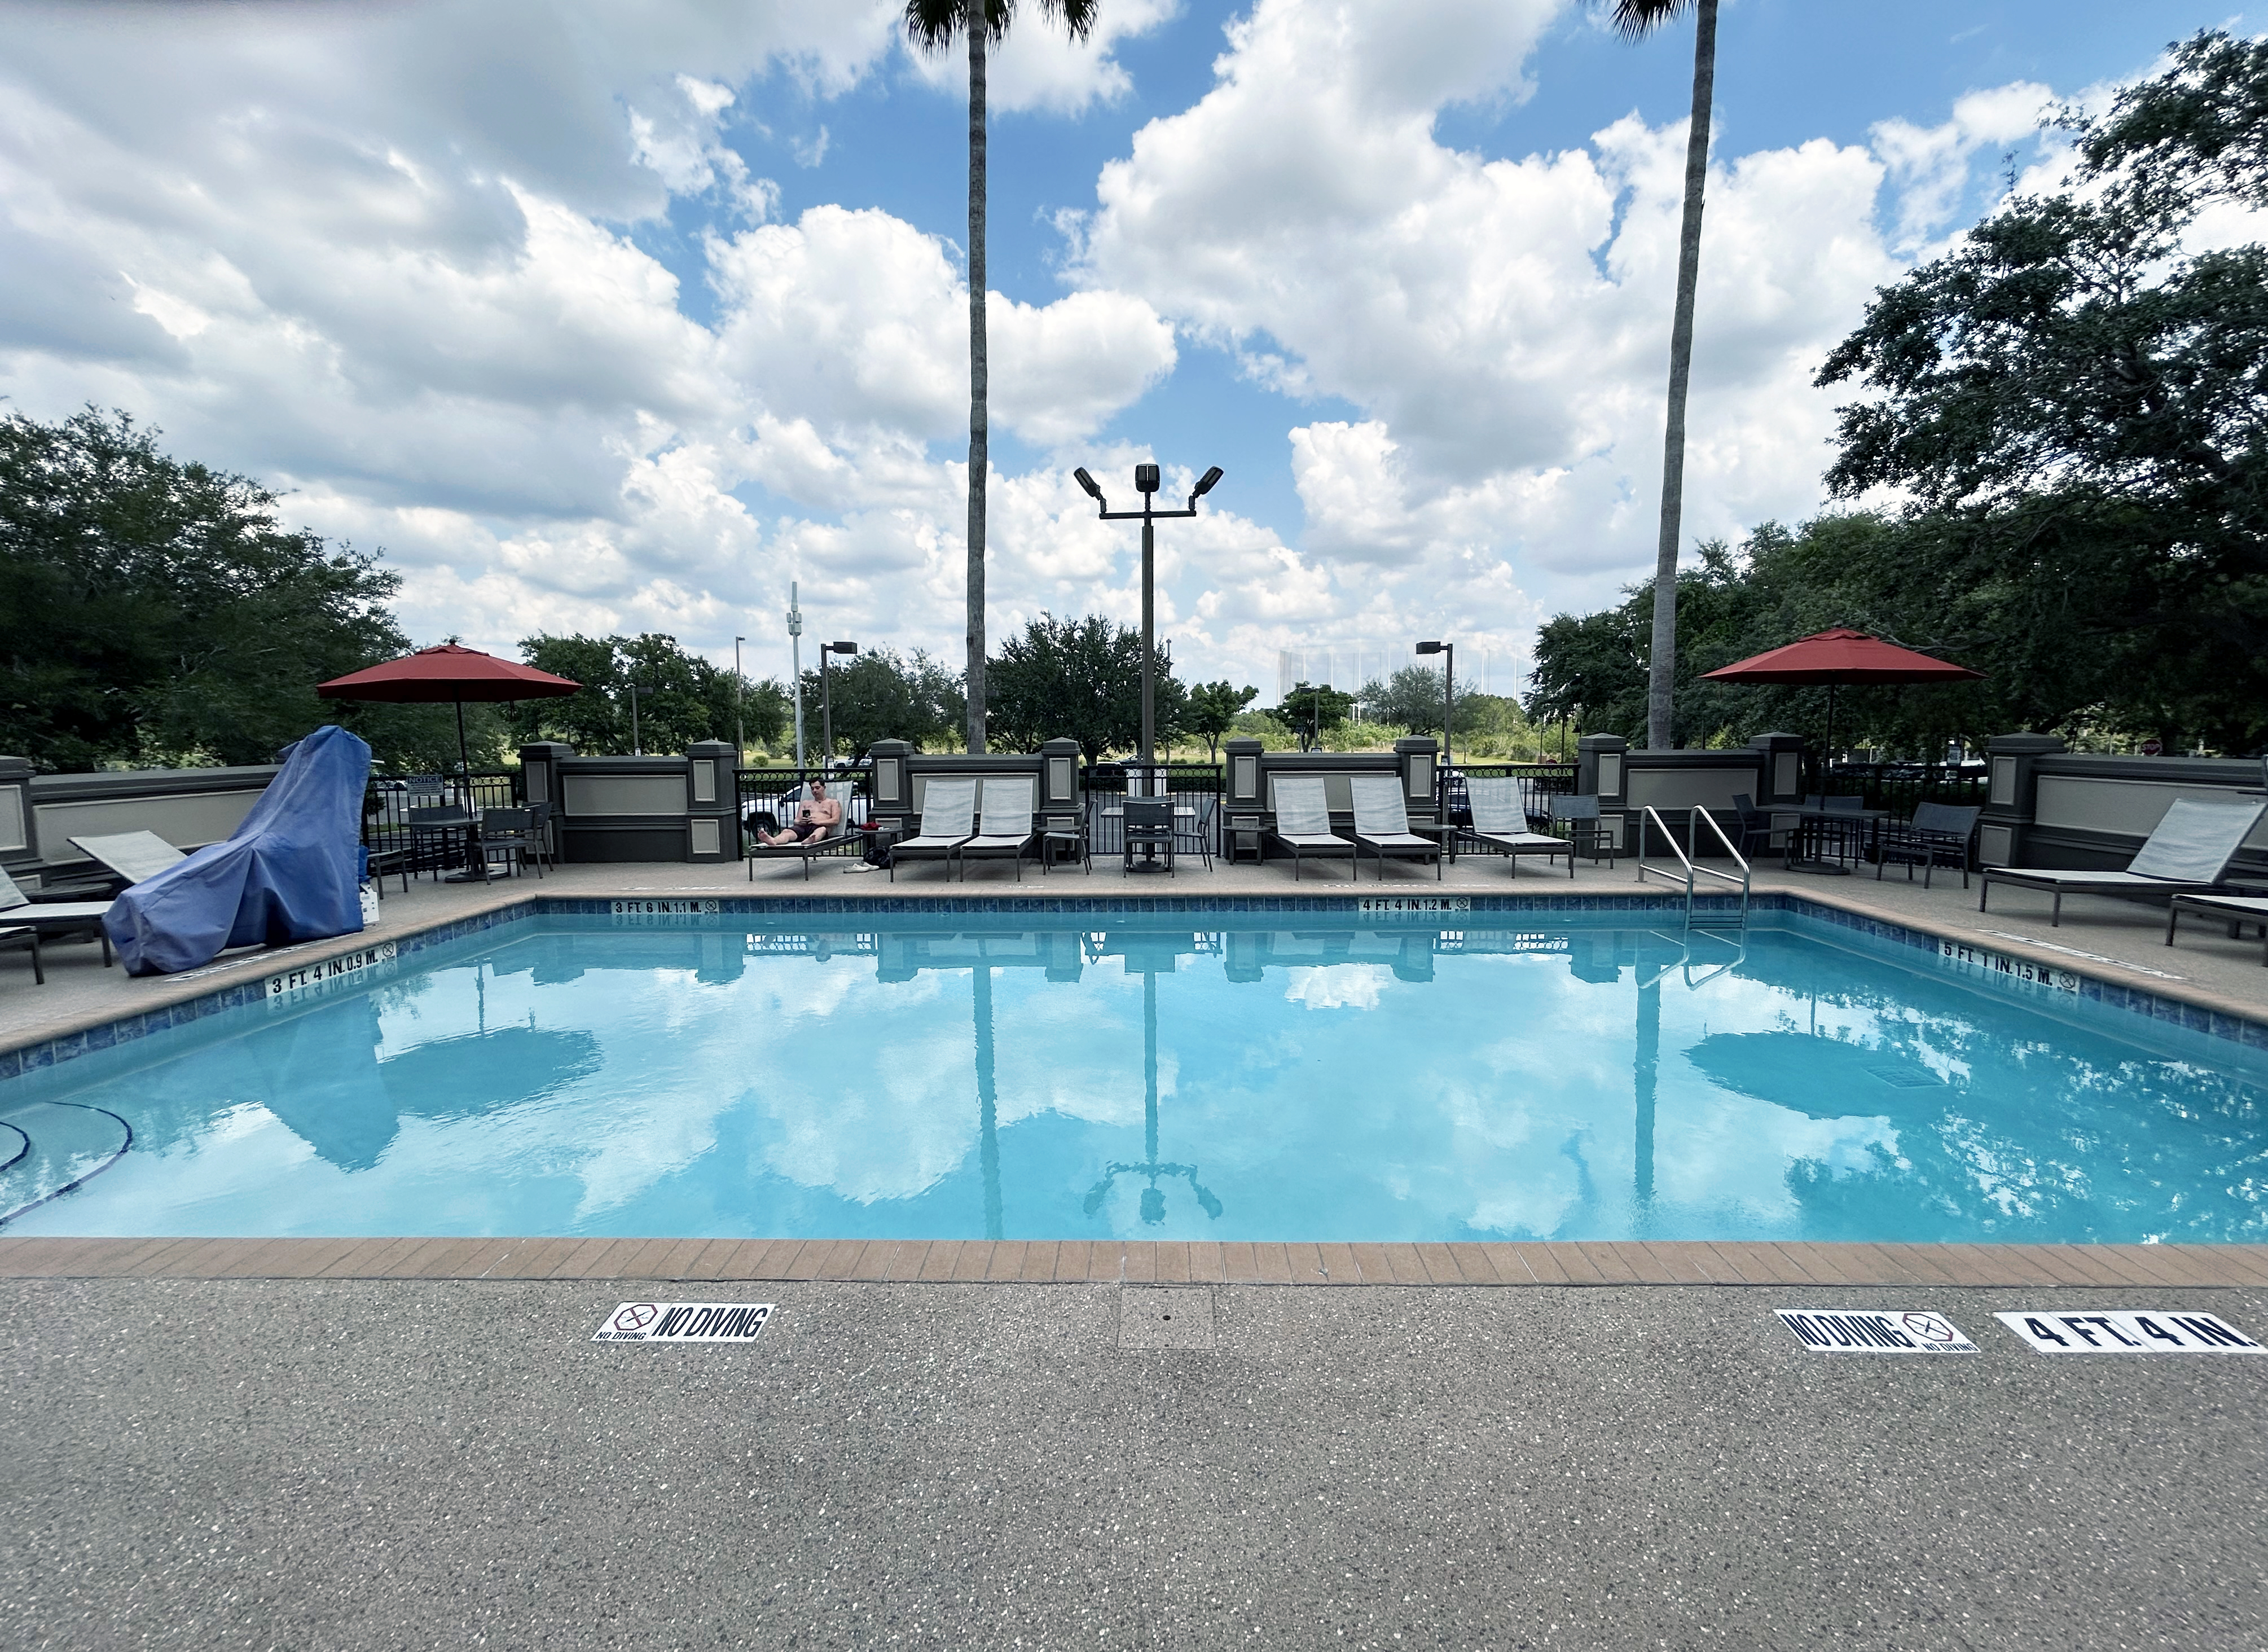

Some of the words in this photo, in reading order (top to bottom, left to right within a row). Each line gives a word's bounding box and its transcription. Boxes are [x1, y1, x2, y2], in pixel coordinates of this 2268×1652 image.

[616, 902, 622, 913] 3
[628, 902, 641, 913] FT.
[647, 902, 653, 913] 6
[658, 902, 672, 913] IN.
[675, 902, 686, 913] 1.1
[690, 902, 701, 913] M.
[1363, 899, 1370, 911] 4
[1375, 899, 1390, 911] FT.
[1395, 899, 1402, 911] 4
[1408, 899, 1421, 911] IN.
[1423, 899, 1437, 911] 1.2
[1440, 899, 1452, 911] M.
[272, 978, 282, 994] 3
[289, 970, 307, 989] FT.
[313, 966, 322, 980] 4
[328, 961, 345, 977] IN.
[347, 954, 362, 971] 0.9
[366, 950, 378, 965] M.
[1944, 942, 1951, 956] 5
[1958, 945, 1973, 963] FT.
[1982, 953, 1987, 966] 1
[1996, 957, 2012, 974] IN.
[2016, 964, 2033, 980] 1.5
[2038, 968, 2052, 986] M.
[652, 1307, 694, 1337] NO
[684, 1307, 768, 1337] DIVING
[1779, 1314, 1831, 1347] NO
[1813, 1315, 1917, 1348] DIVING
[2024, 1317, 2071, 1346] 4
[2058, 1317, 2142, 1346] FT.
[2134, 1317, 2186, 1346] 4
[2168, 1317, 2258, 1347] IN.
[1921, 1343, 1940, 1351] NO
[1942, 1343, 1978, 1352] DIVING
